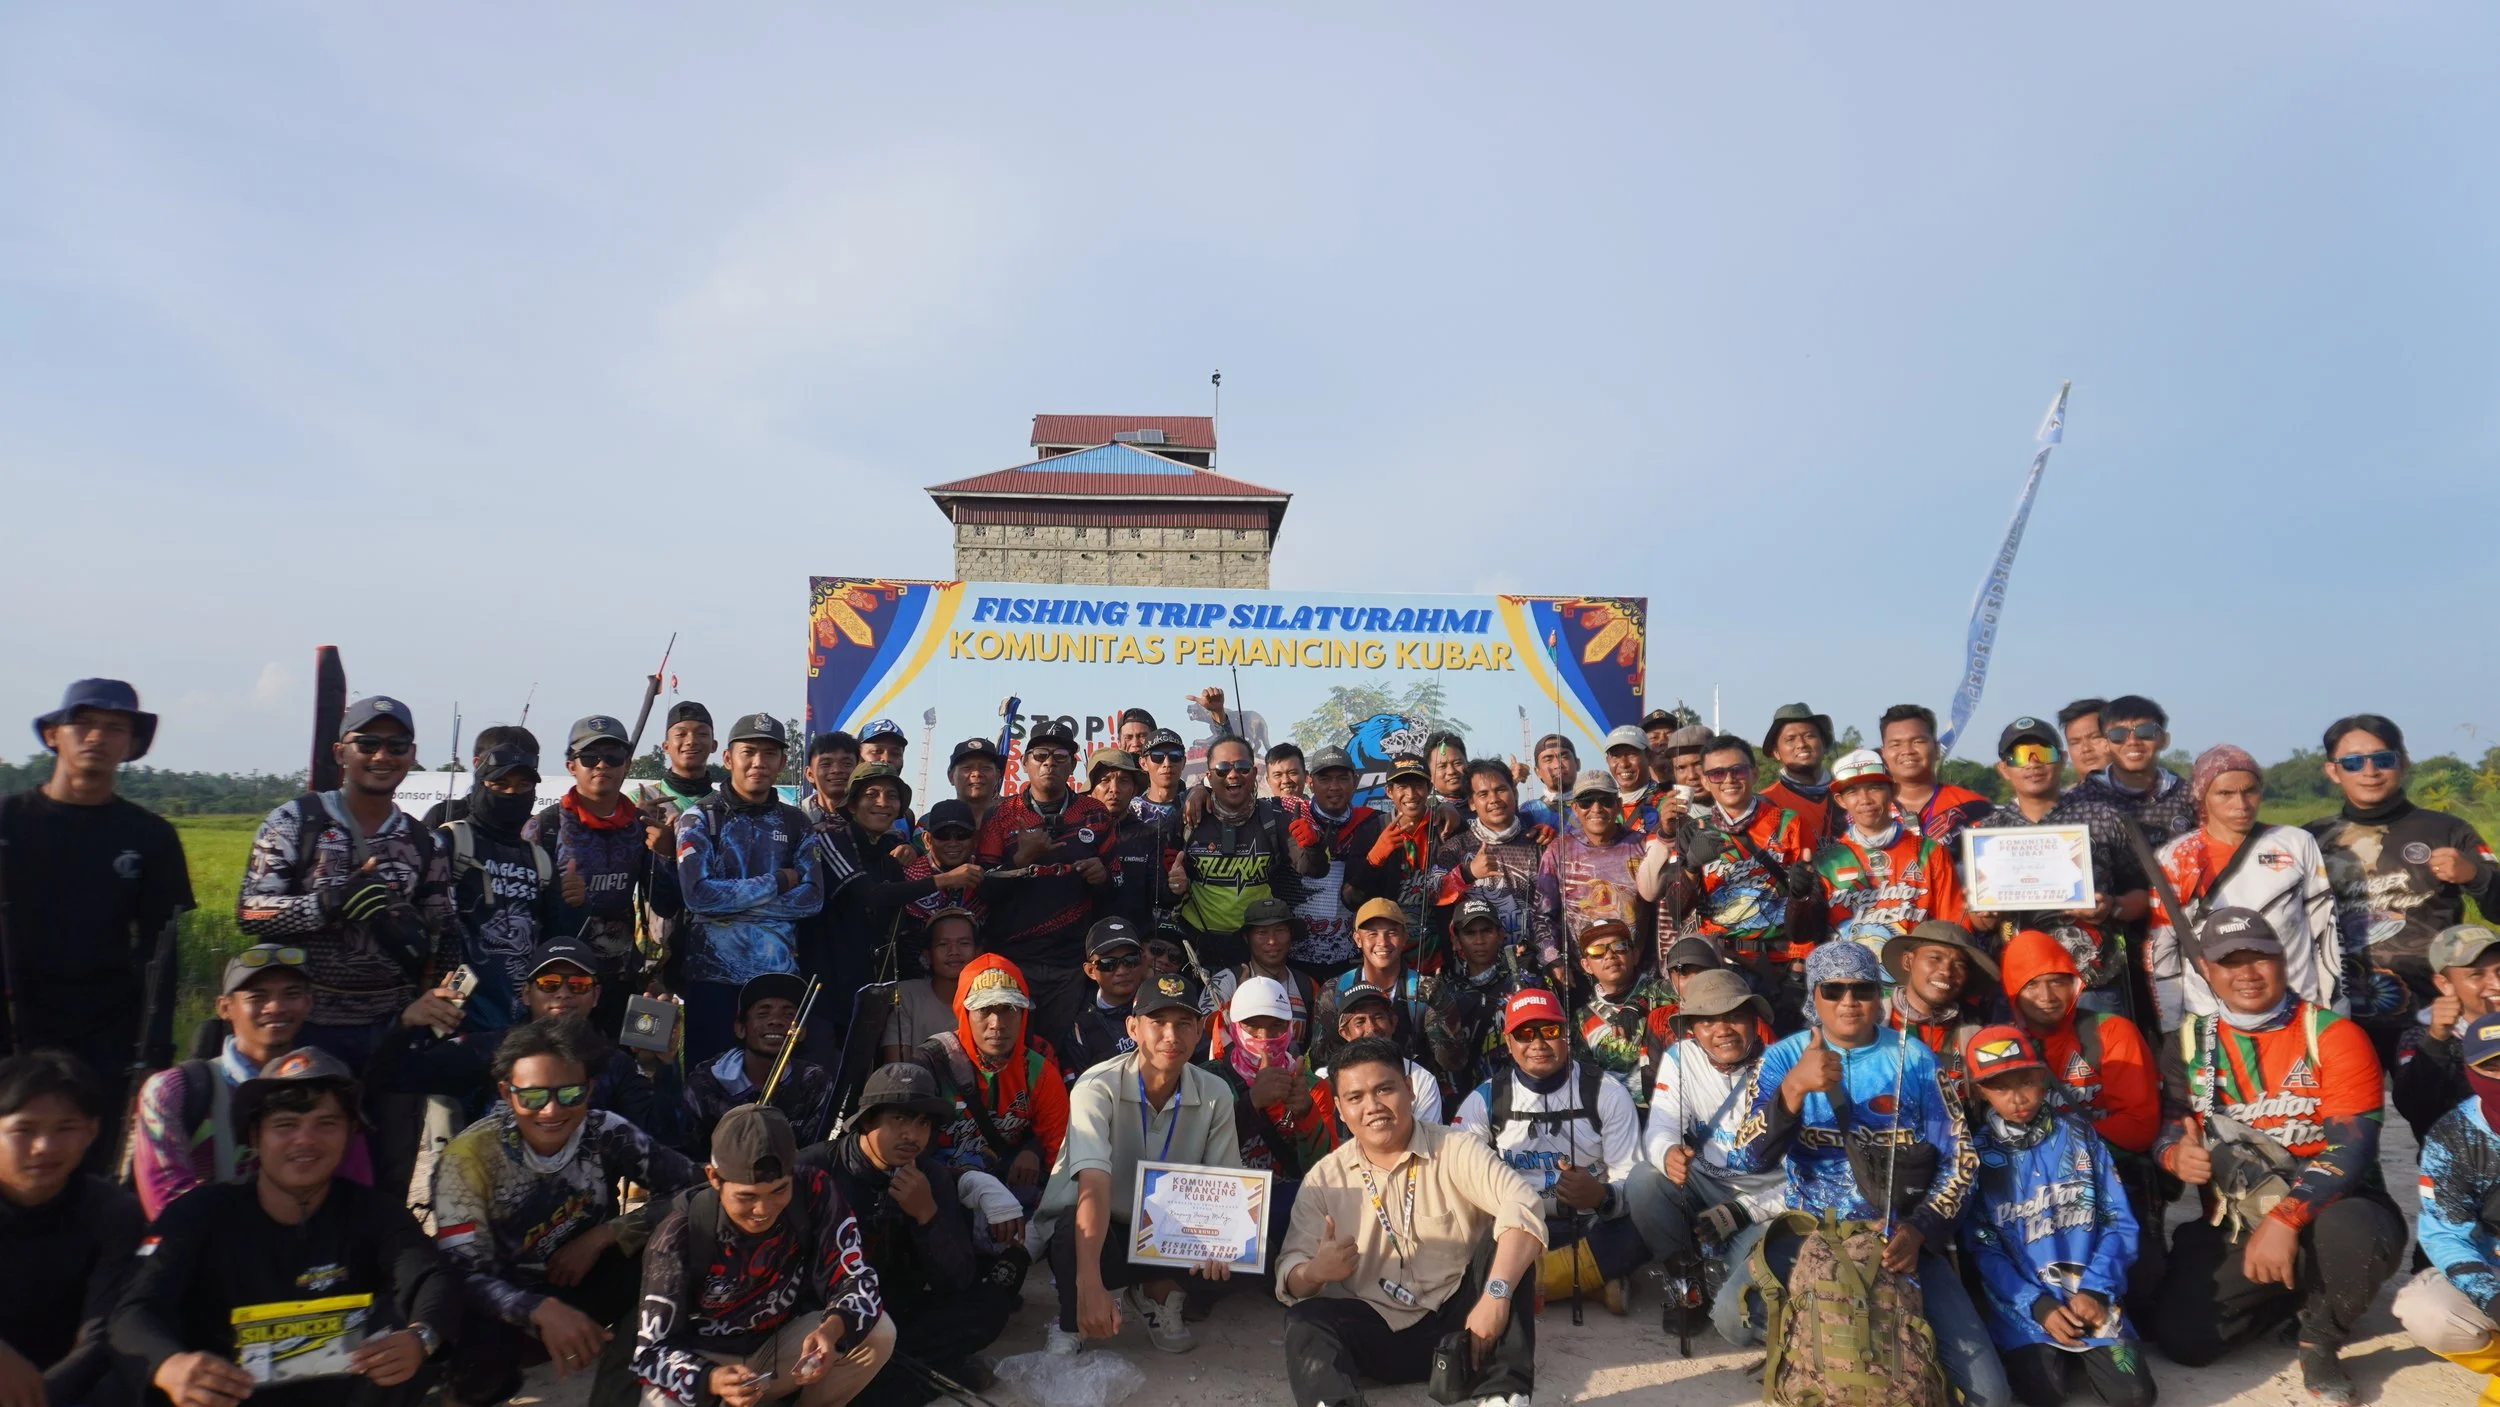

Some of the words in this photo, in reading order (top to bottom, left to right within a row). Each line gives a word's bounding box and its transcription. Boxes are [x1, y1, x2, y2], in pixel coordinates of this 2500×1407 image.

[972, 597, 1128, 627] FISHING
[1136, 601, 1226, 628] TRIP
[1229, 603, 1493, 634] SILATURAHMI
[950, 629, 1165, 664] KOMUNITAS
[1174, 635, 1386, 669] PEMANCING
[1394, 640, 1514, 671] KUBAR
[1464, 905, 1490, 914] Tractors
[2219, 922, 2246, 935] PUMA
[1344, 981, 1384, 998] SHIMANO
[1172, 1177, 1237, 1189] KOMUNITAS
[1172, 1185, 1236, 1197] PEMANCING
[1184, 1193, 1220, 1203] KUBAR
[1161, 1240, 1208, 1251] FISHING
[1212, 1244, 1238, 1252] TRIP
[1160, 1247, 1238, 1260] SILATURAHMI
